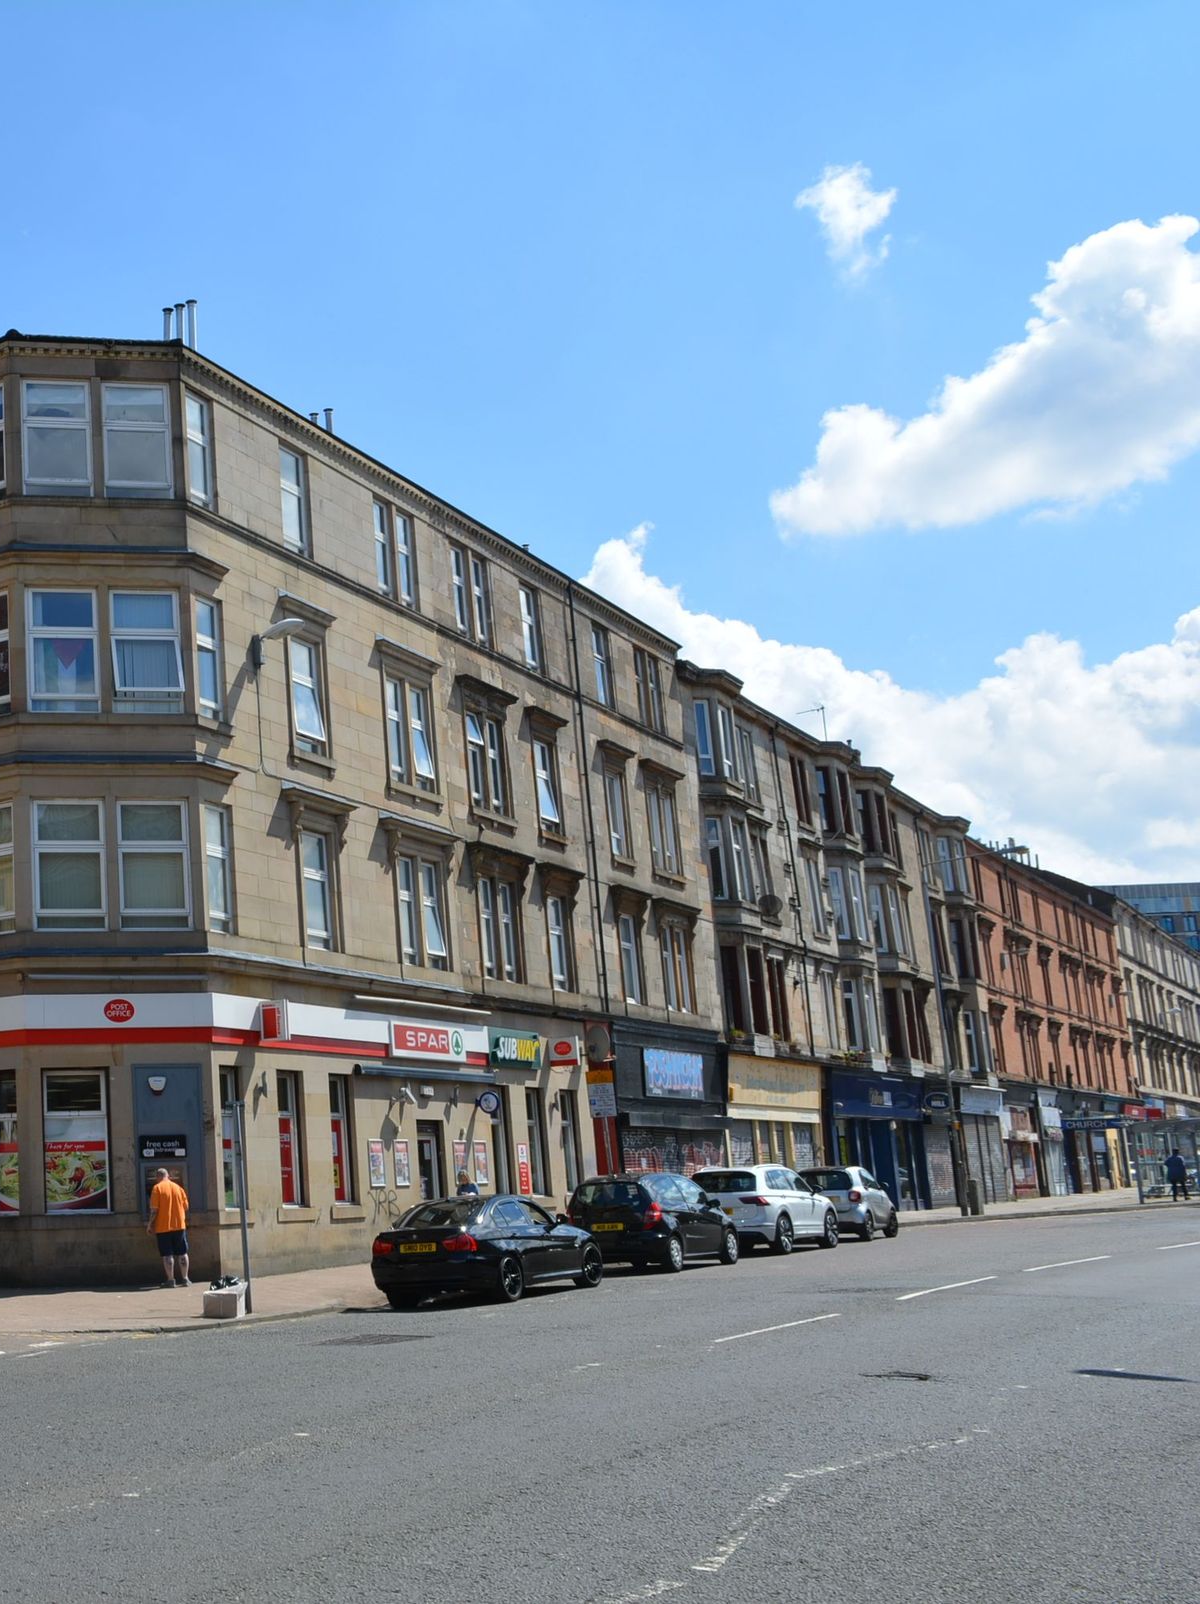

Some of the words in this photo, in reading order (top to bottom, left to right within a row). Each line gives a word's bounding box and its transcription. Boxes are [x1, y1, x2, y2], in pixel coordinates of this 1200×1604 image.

[405, 1031, 448, 1049] SPAR
[497, 1036, 540, 1062] SUBWAY
[1065, 1121, 1107, 1129] CHURCH
